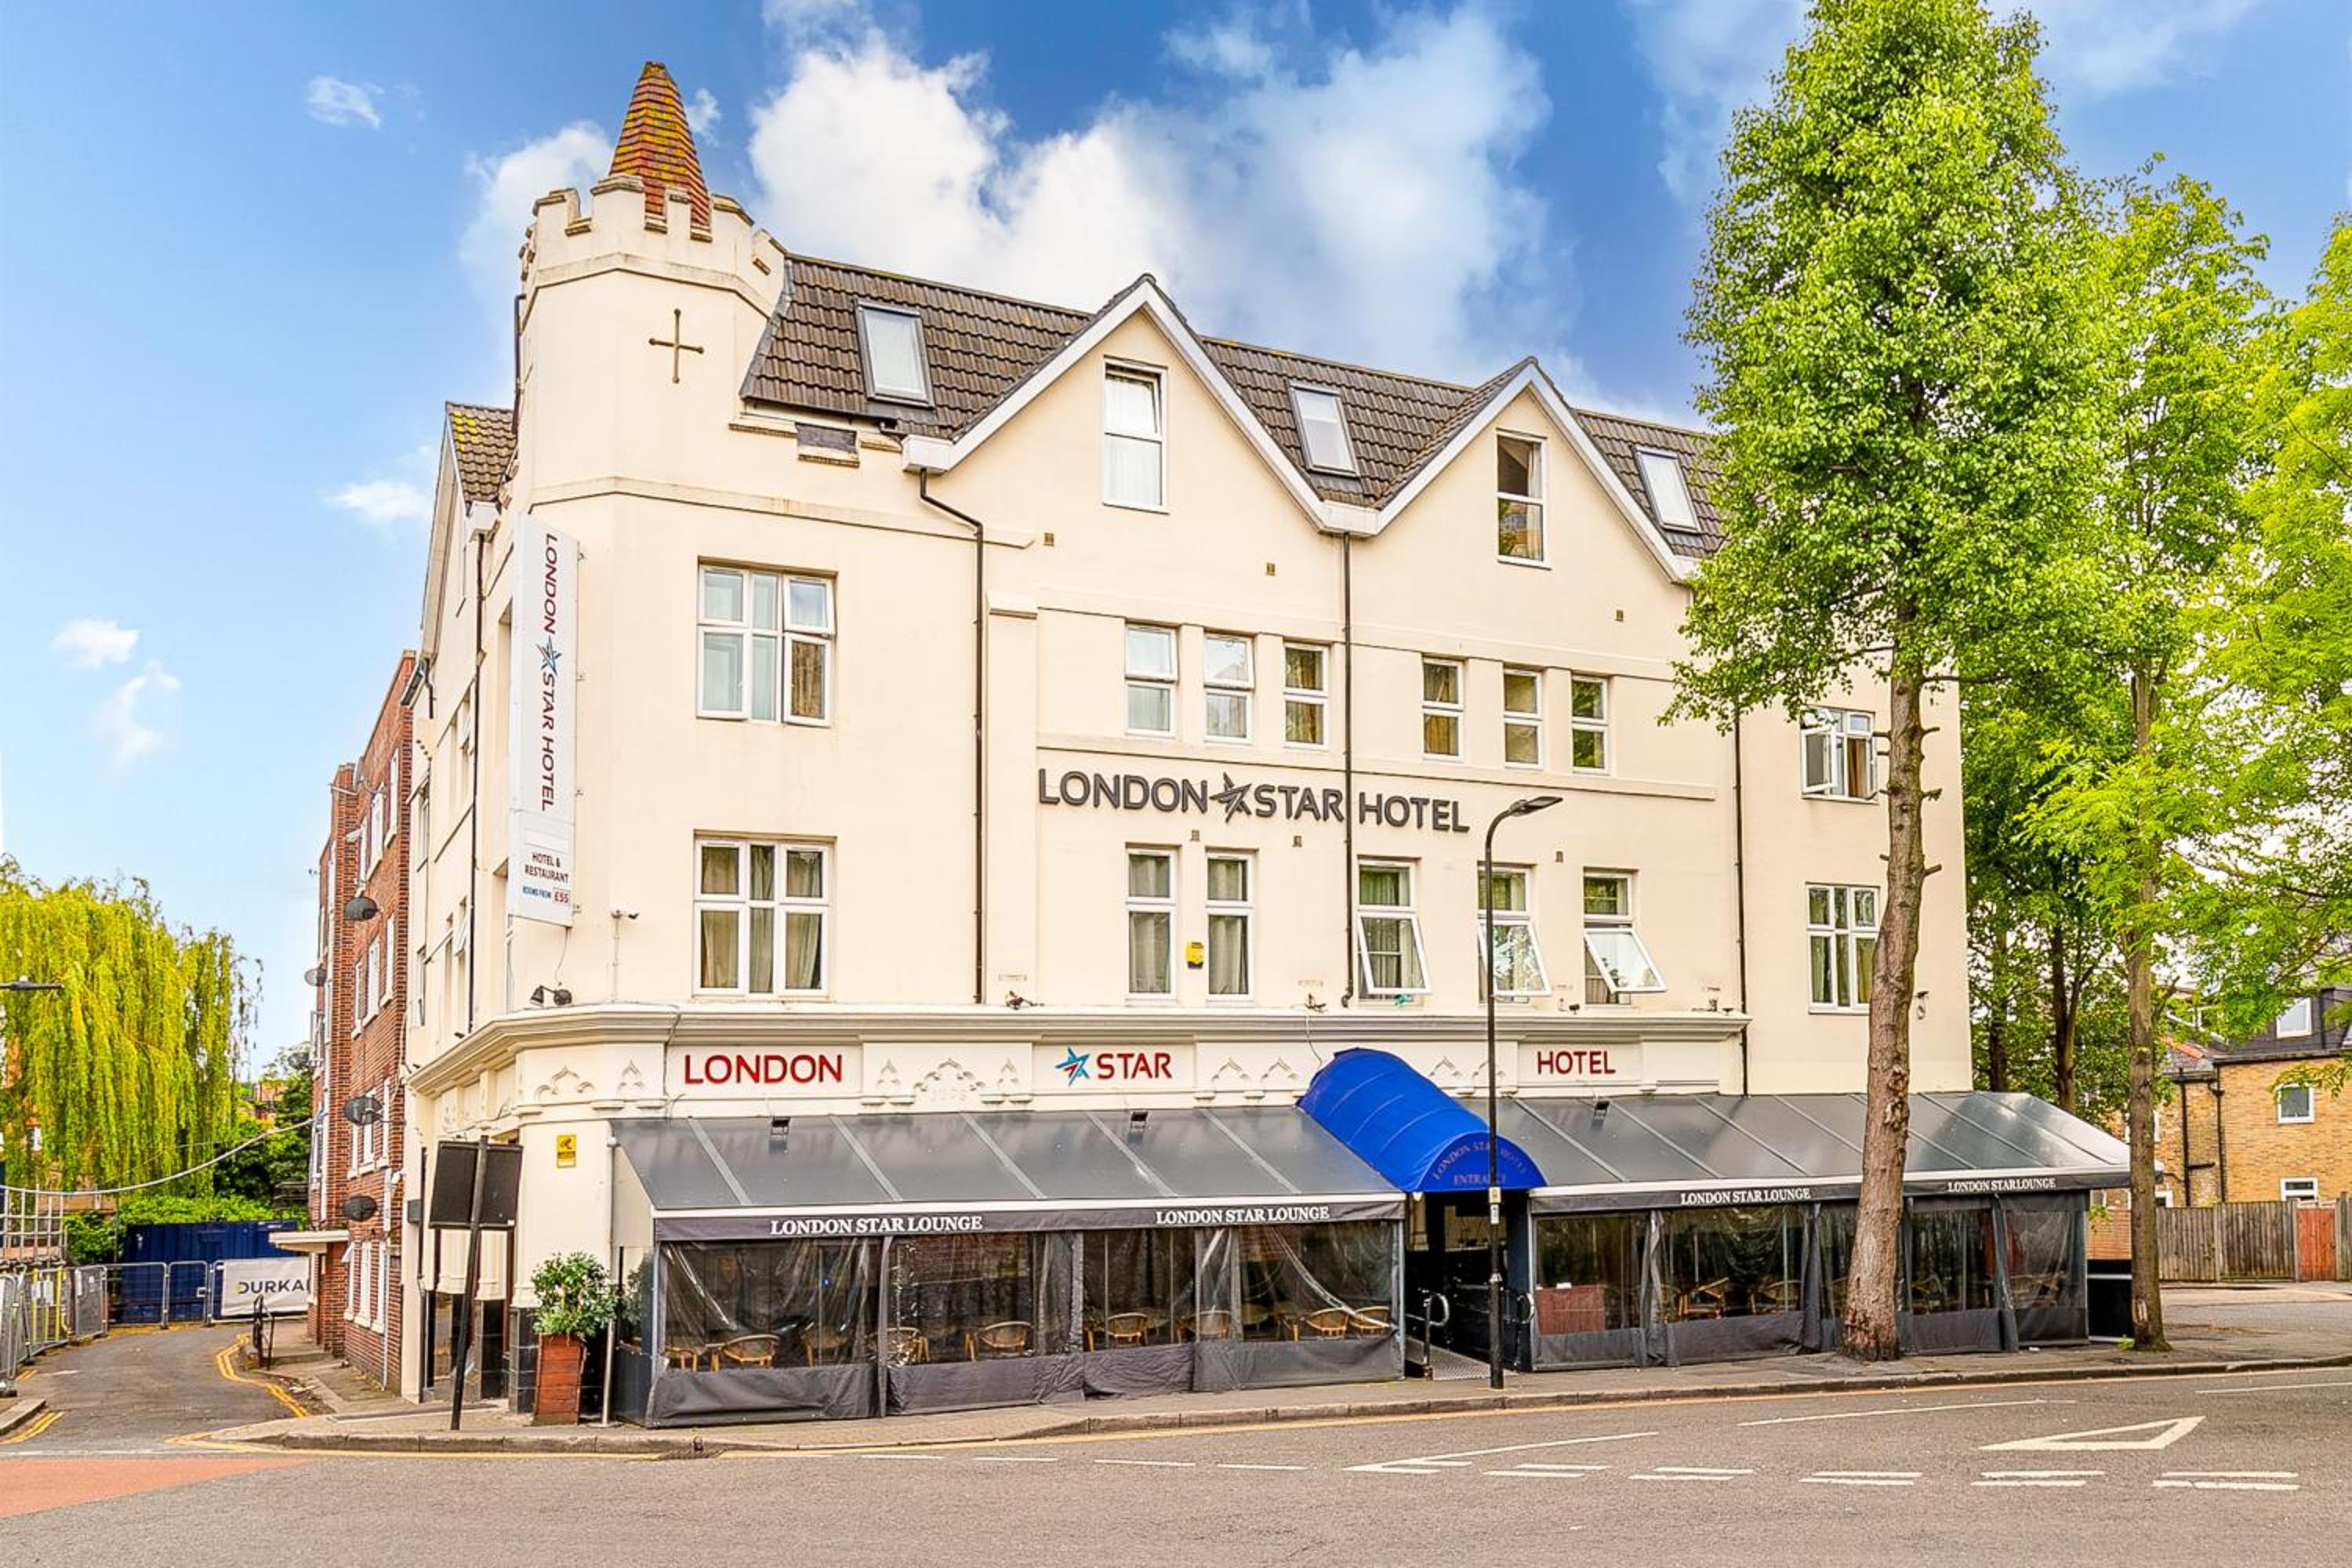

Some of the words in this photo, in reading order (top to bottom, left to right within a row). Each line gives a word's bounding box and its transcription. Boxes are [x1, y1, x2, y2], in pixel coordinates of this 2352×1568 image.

[543, 533, 558, 634] LONDON
[542, 671, 555, 731] STAR
[542, 735, 554, 811] HOTEL
[1038, 768, 1208, 814] LONDON
[1255, 784, 1345, 822] STAR
[1359, 792, 1471, 833] HOTEL
[532, 852, 554, 866] HOTEL
[524, 864, 568, 884] RESTAURANT
[684, 1054, 843, 1084] LONDON
[1096, 1052, 1173, 1081] STAR
[1537, 1051, 1617, 1075] HOTEL
[1432, 1145, 1472, 1180] LONDON
[1454, 1173, 1506, 1186] ENTRACE
[1947, 1180, 1991, 1192] LONDON
[1991, 1179, 2016, 1191] STAR
[2016, 1177, 2056, 1190] LOUNGE
[1680, 1191, 1731, 1205] LONDON
[1733, 1189, 1762, 1203] STAR
[1763, 1188, 1812, 1201] LOUNGE
[1156, 1209, 1223, 1225] LONDON
[1225, 1207, 1266, 1222] STAR
[1267, 1206, 1330, 1221] LOUNGE
[770, 1218, 853, 1236] LONDON
[855, 1218, 906, 1234] STAR
[907, 1216, 983, 1232] LOUNGE
